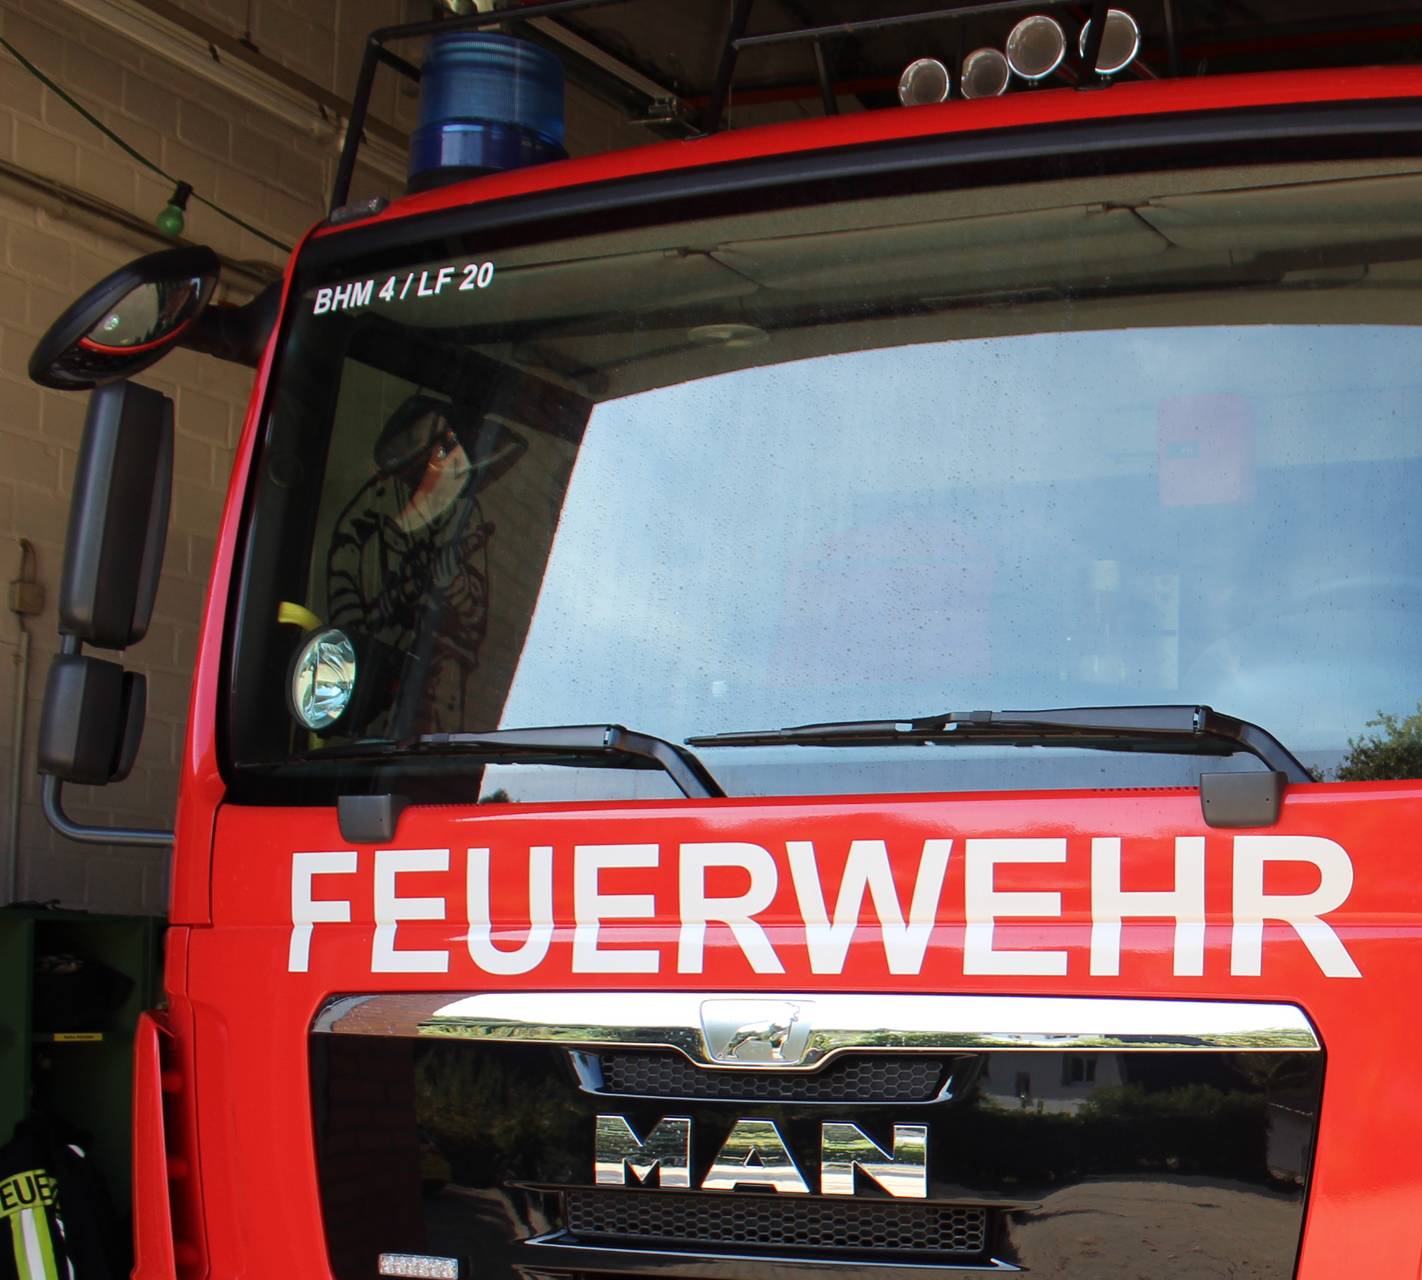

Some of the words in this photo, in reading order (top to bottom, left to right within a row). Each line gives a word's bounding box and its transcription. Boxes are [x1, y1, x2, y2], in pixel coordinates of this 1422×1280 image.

[313, 279, 374, 315] BHM
[378, 275, 396, 302] 4
[399, 272, 415, 300] /
[417, 266, 455, 297] LF
[459, 261, 494, 291] 20
[287, 835, 1363, 979] FEUERWEHR
[595, 1114, 928, 1198] MAN
